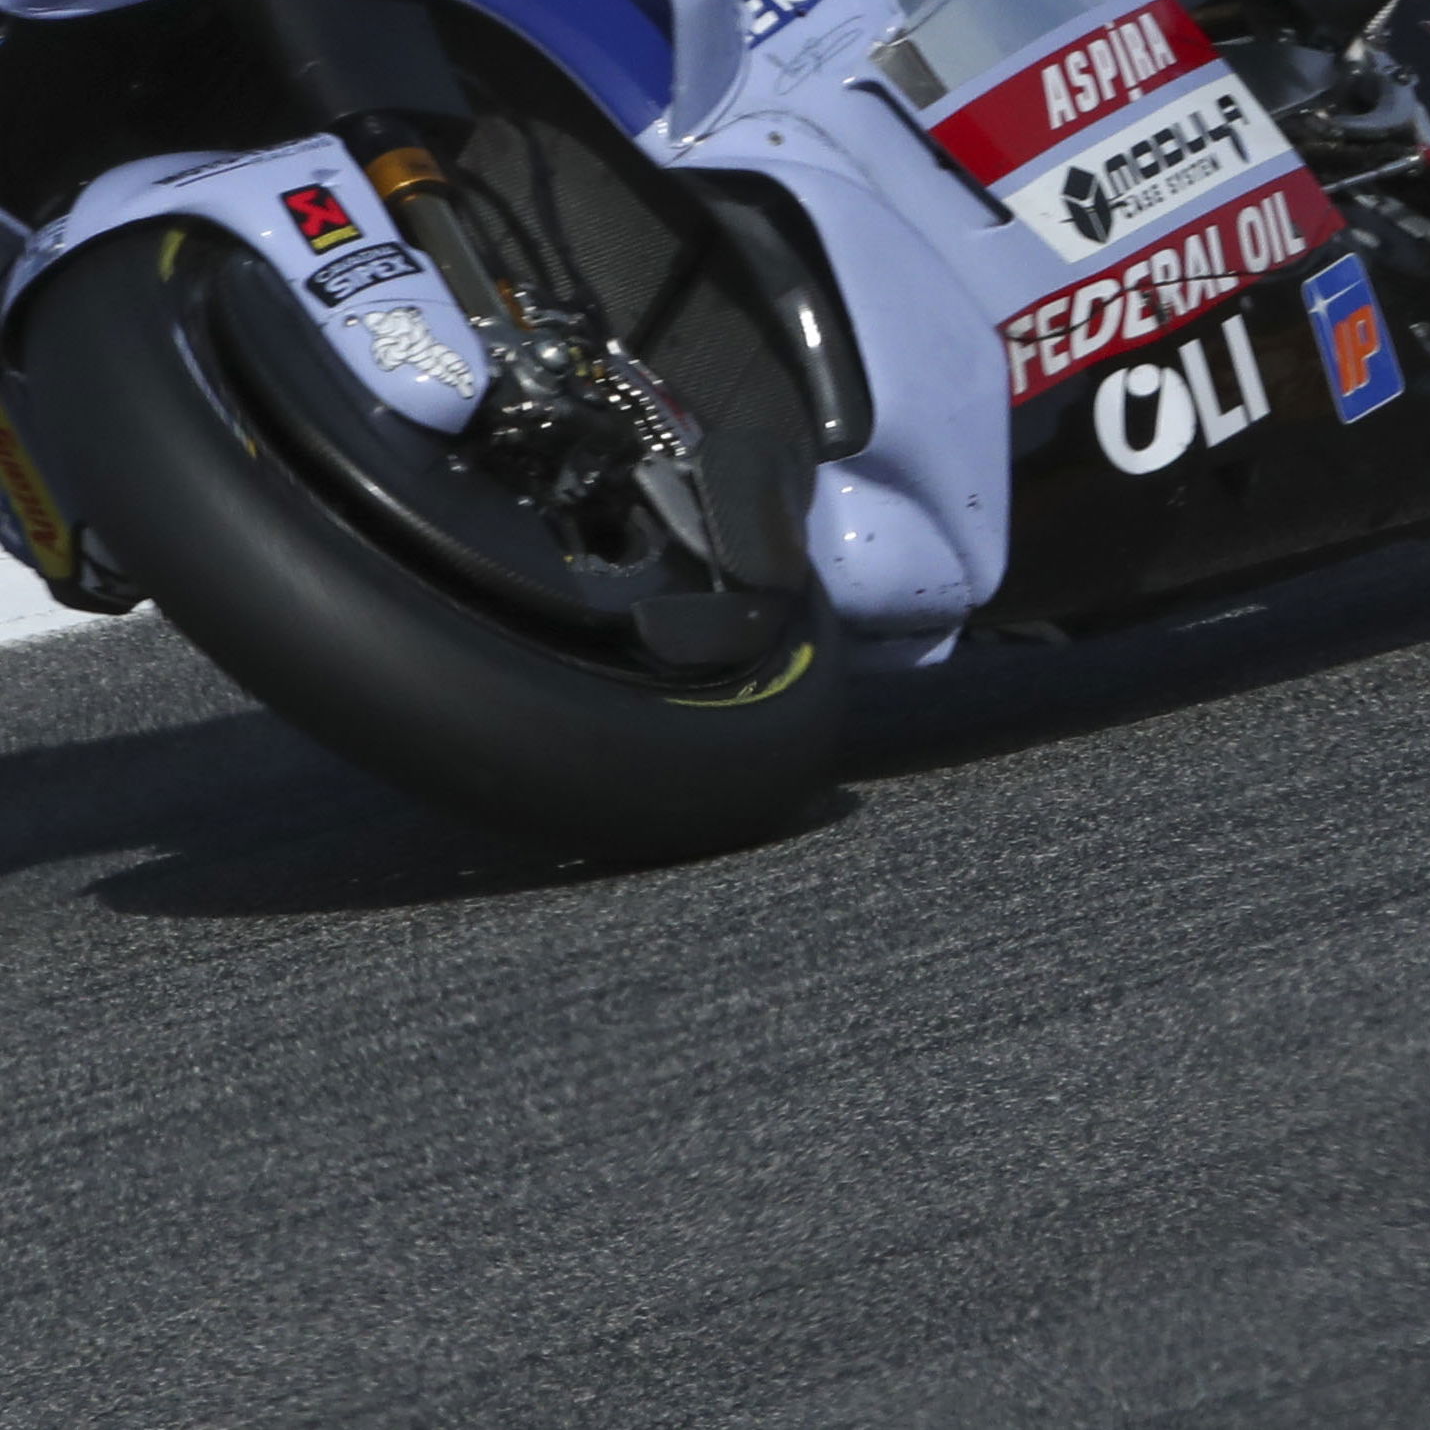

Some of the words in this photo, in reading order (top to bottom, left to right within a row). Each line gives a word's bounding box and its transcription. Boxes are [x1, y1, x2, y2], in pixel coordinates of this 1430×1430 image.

[1005, 226, 1241, 395] FEDERAL
[1238, 191, 1306, 273] OIL
[1332, 303, 1380, 396] IP
